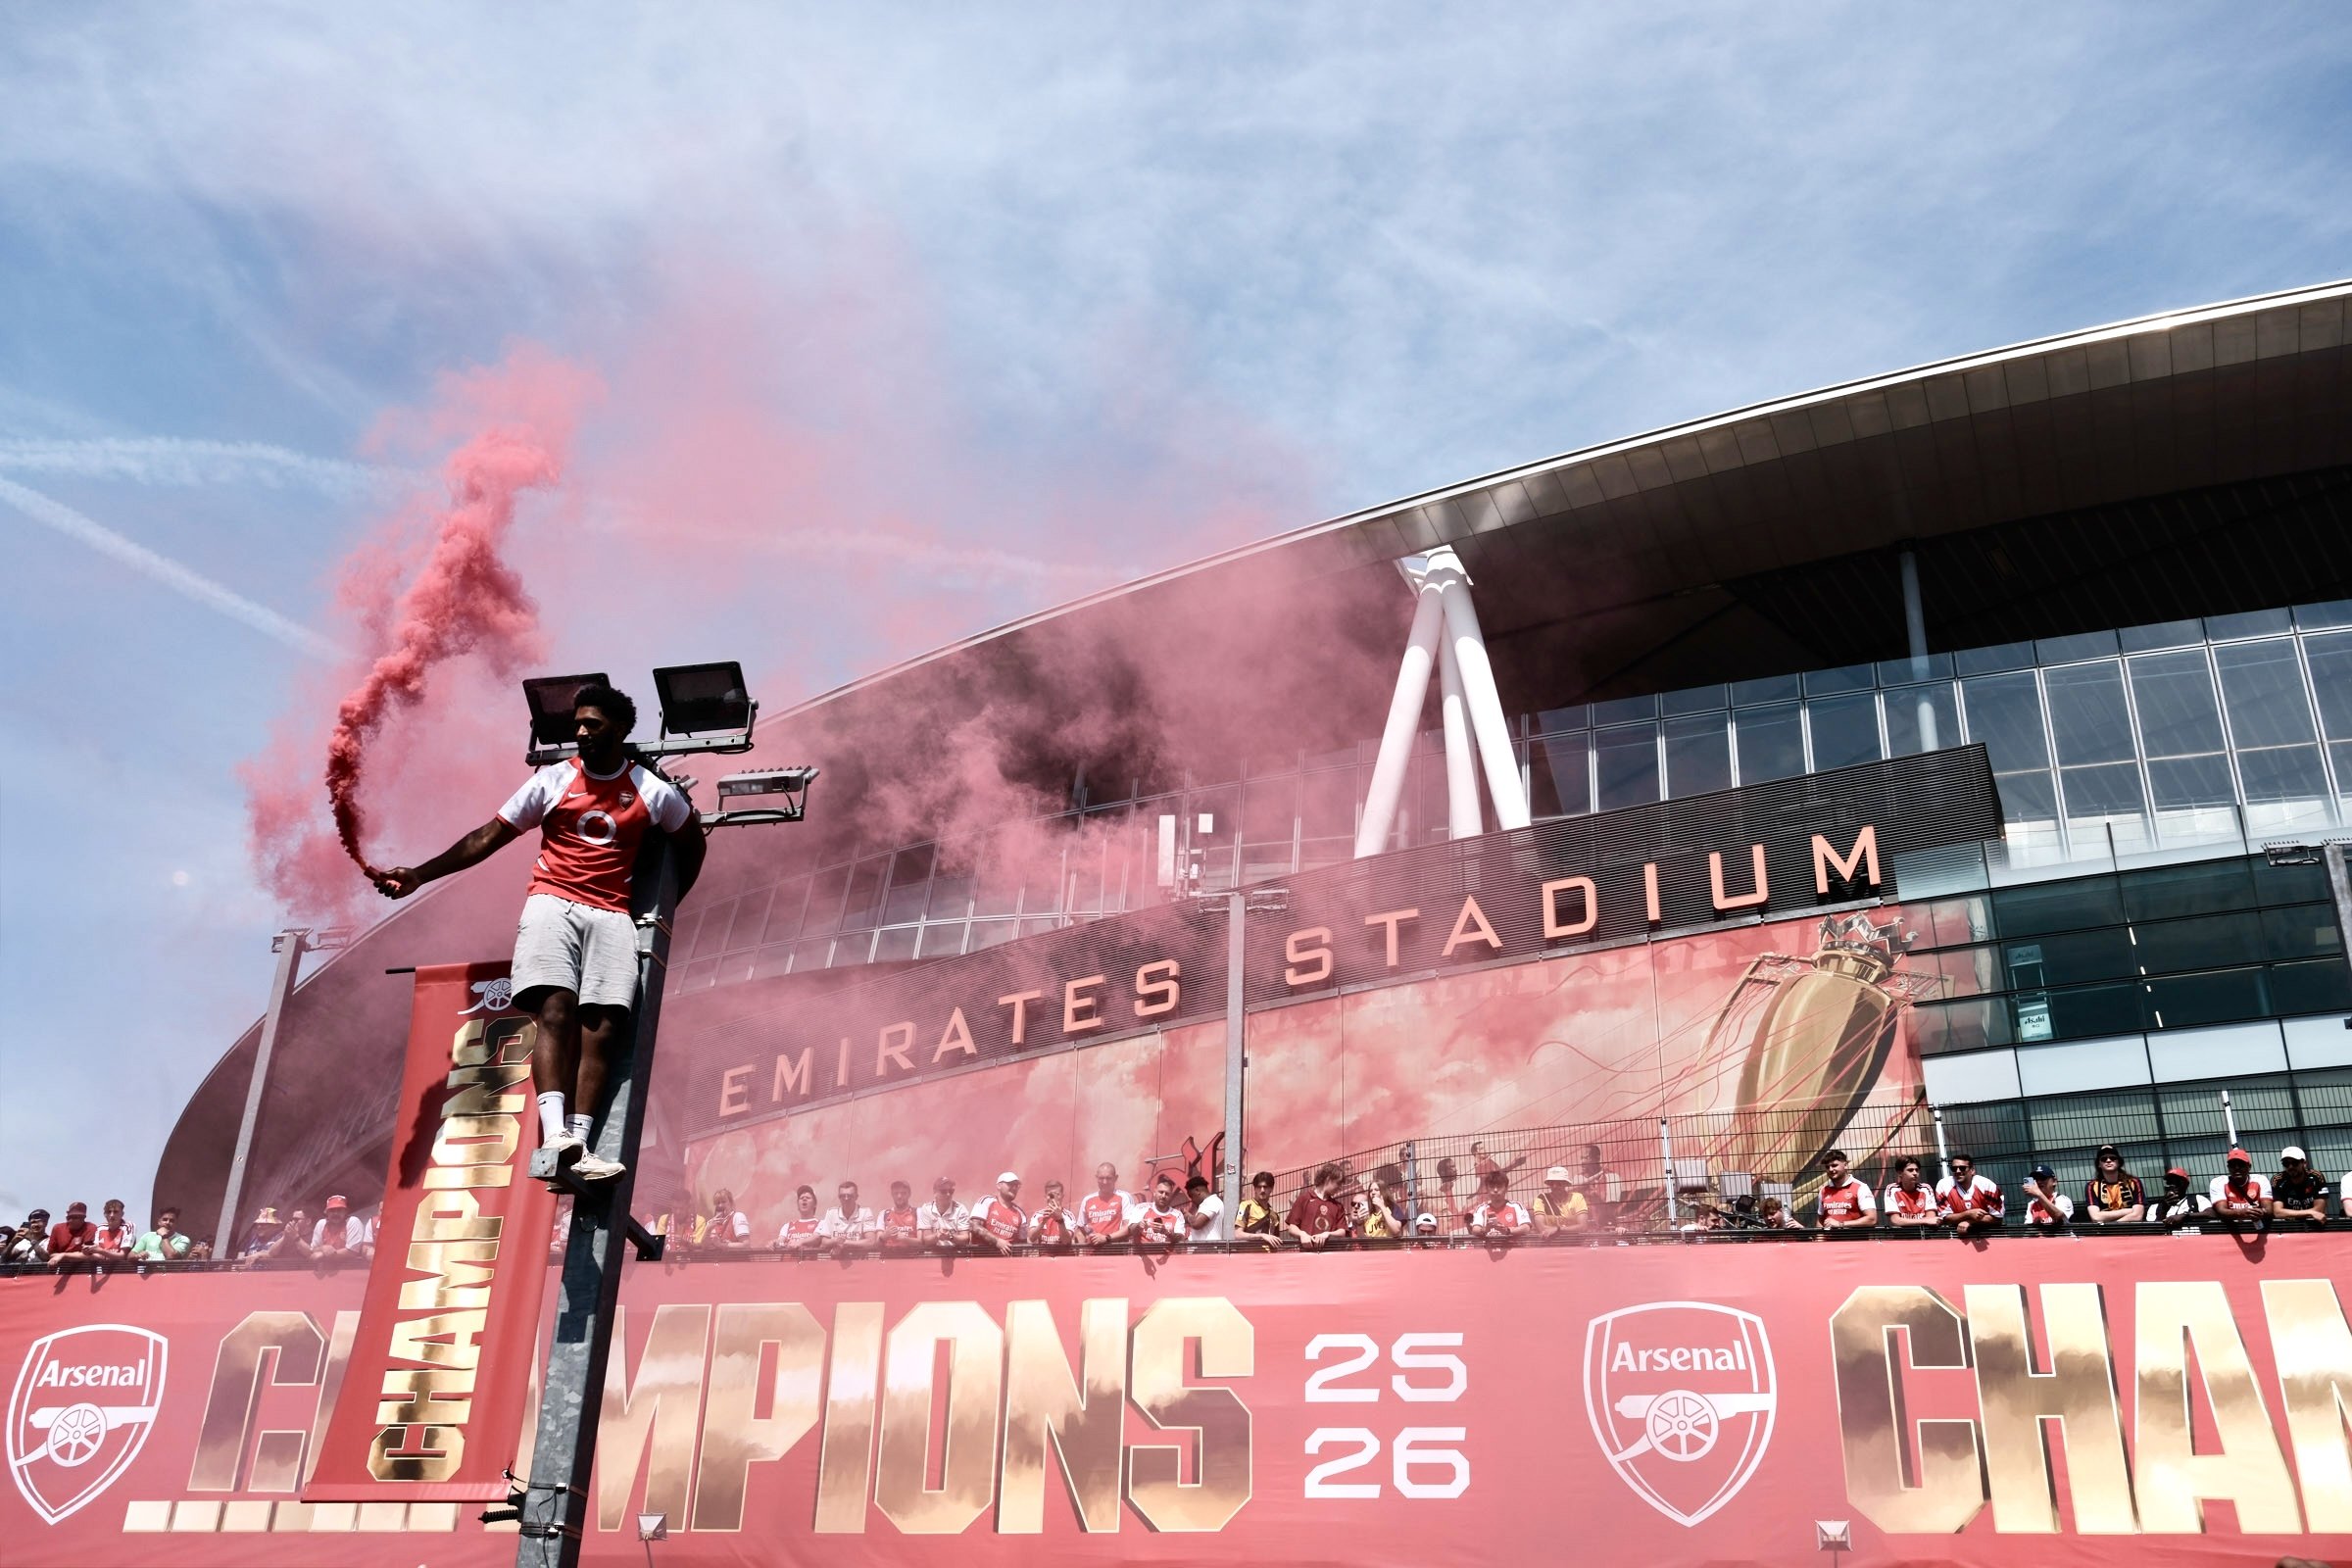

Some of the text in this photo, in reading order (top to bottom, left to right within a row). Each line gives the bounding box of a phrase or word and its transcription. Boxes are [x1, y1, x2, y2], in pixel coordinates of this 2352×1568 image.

[718, 826, 1882, 1117] EMIRATES STADIUM
[2024, 1015, 2045, 1025] Asahi
[367, 1016, 538, 1483] CHAMPIONS
[36, 1357, 146, 1388] Arsenal
[1304, 1332, 1468, 1402] 25
[1611, 1340, 1747, 1372] Arsenal
[1304, 1427, 1470, 1498] 26
